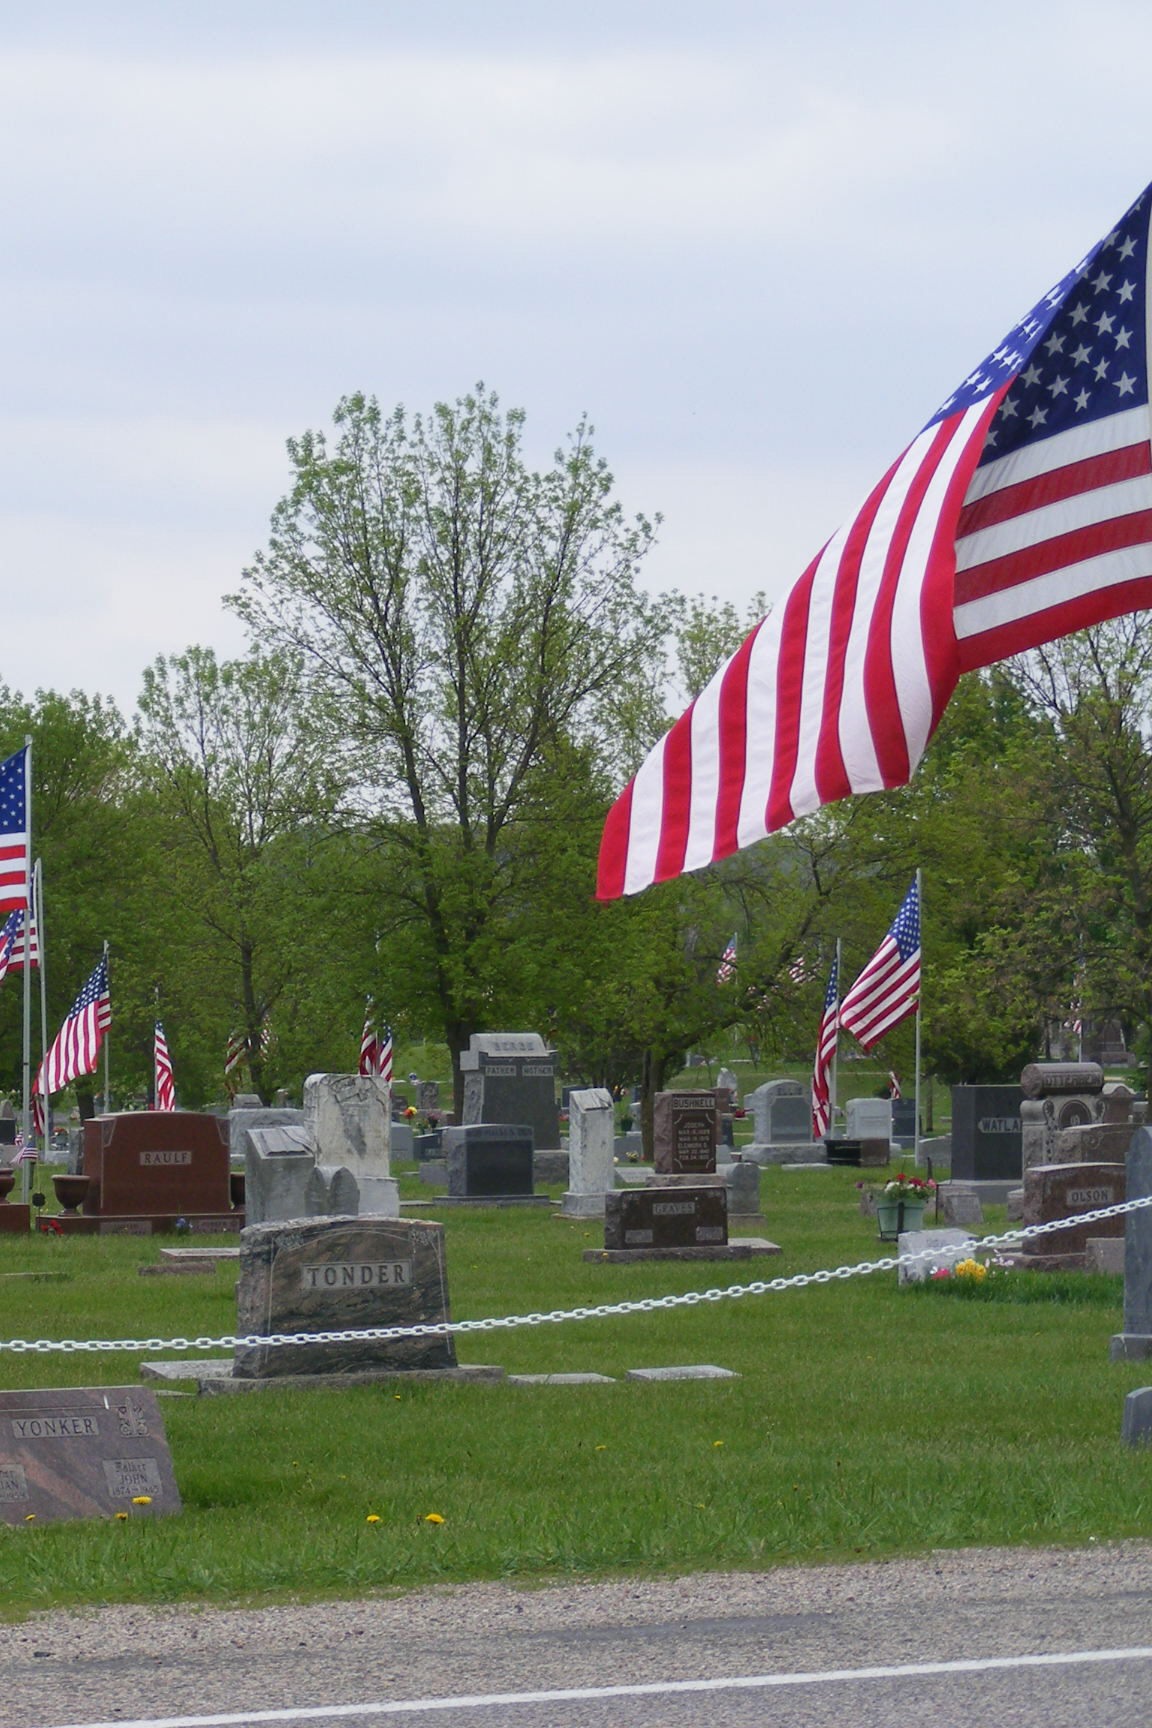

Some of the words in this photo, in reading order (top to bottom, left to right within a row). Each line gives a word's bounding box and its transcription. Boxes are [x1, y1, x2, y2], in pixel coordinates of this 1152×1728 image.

[673, 1098, 715, 1108] BUSHNELL
[982, 1119, 1023, 1131] WATLA
[144, 1152, 188, 1164] RAULF
[1071, 1190, 1108, 1202] OLSON
[655, 1204, 692, 1215] GRAVES
[307, 1264, 405, 1287] TONDER
[16, 1418, 95, 1437] YONKER
